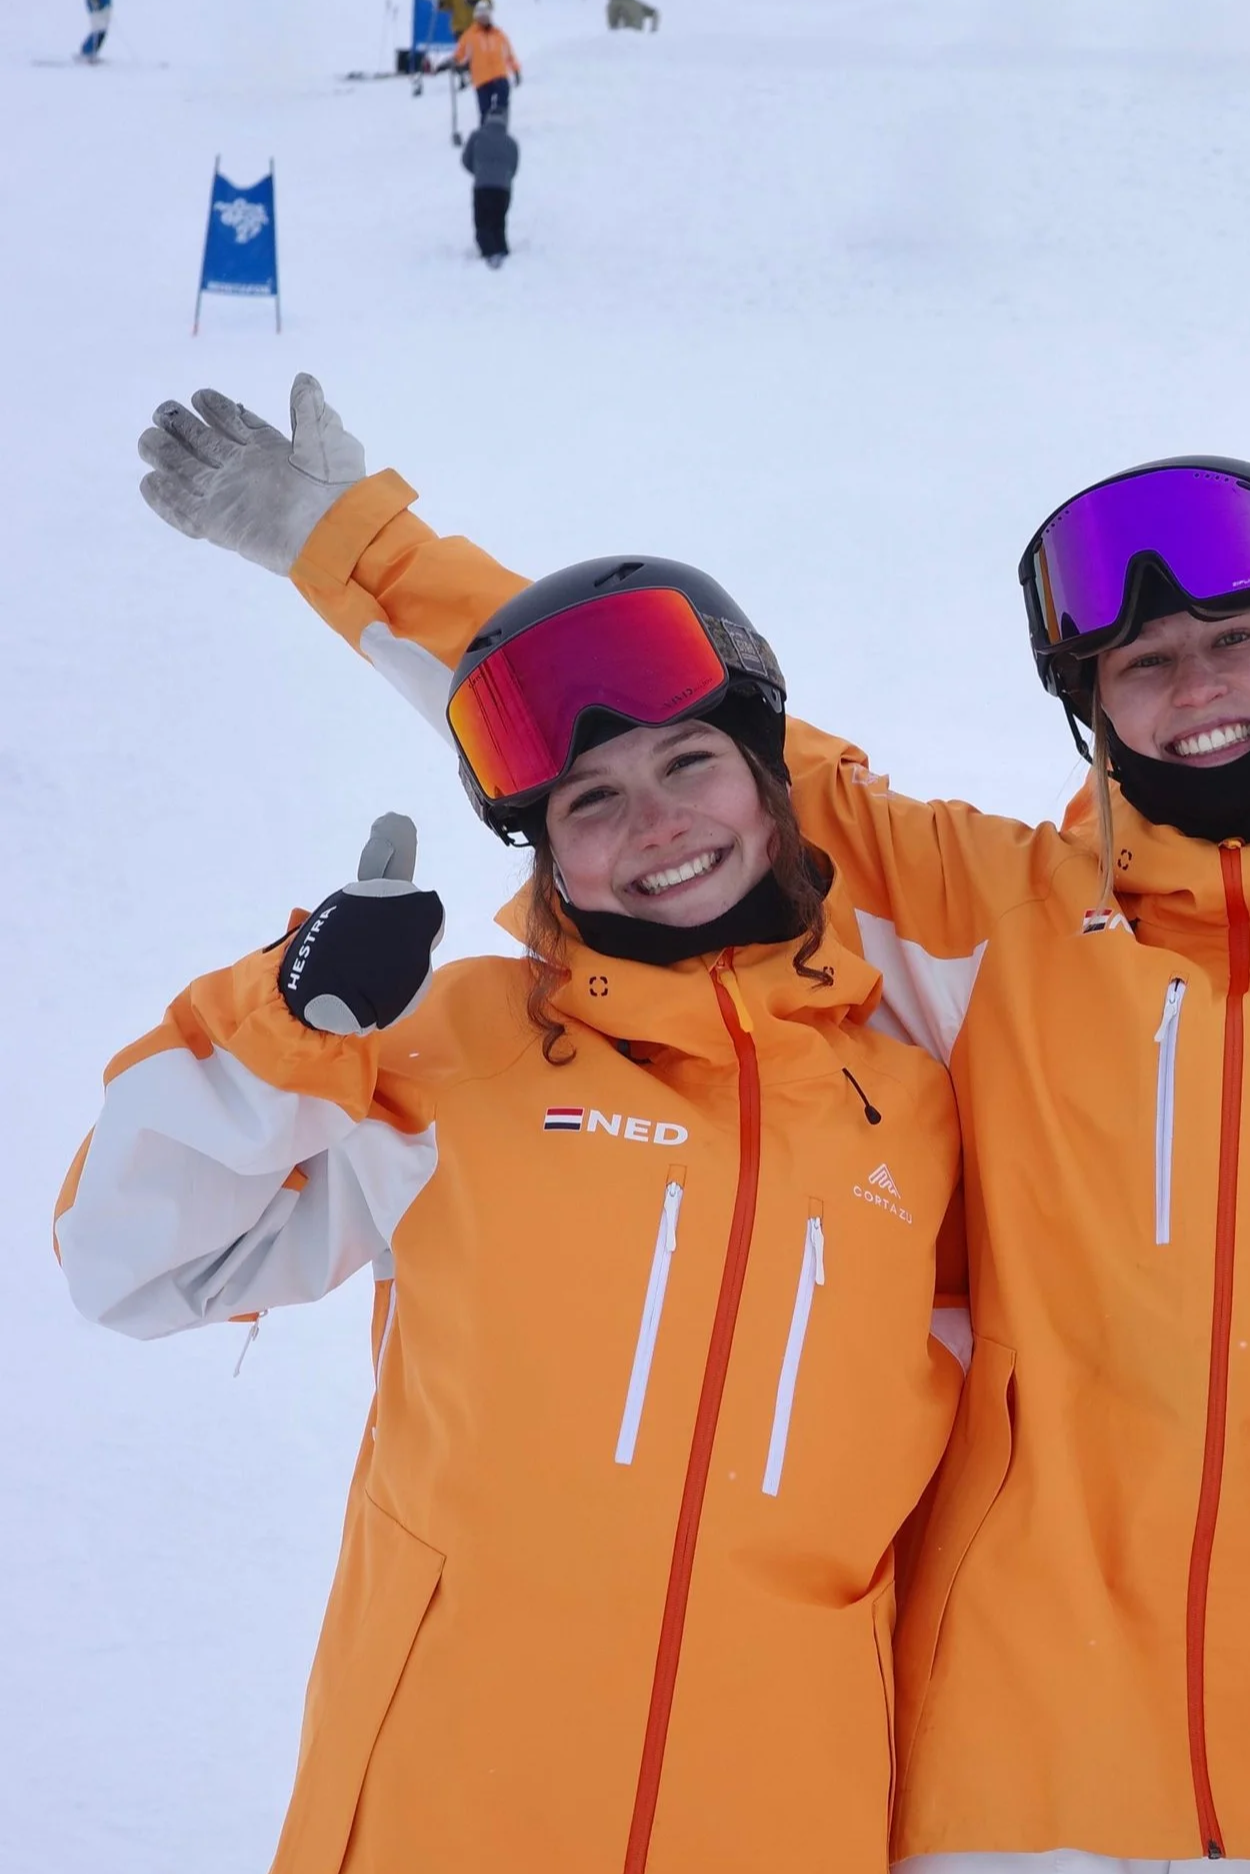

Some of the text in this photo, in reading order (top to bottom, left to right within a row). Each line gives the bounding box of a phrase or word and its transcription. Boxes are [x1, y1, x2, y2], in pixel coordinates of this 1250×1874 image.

[287, 905, 338, 991] HESTRA
[586, 1109, 689, 1147] NED
[853, 1185, 913, 1225] CORTAZU
